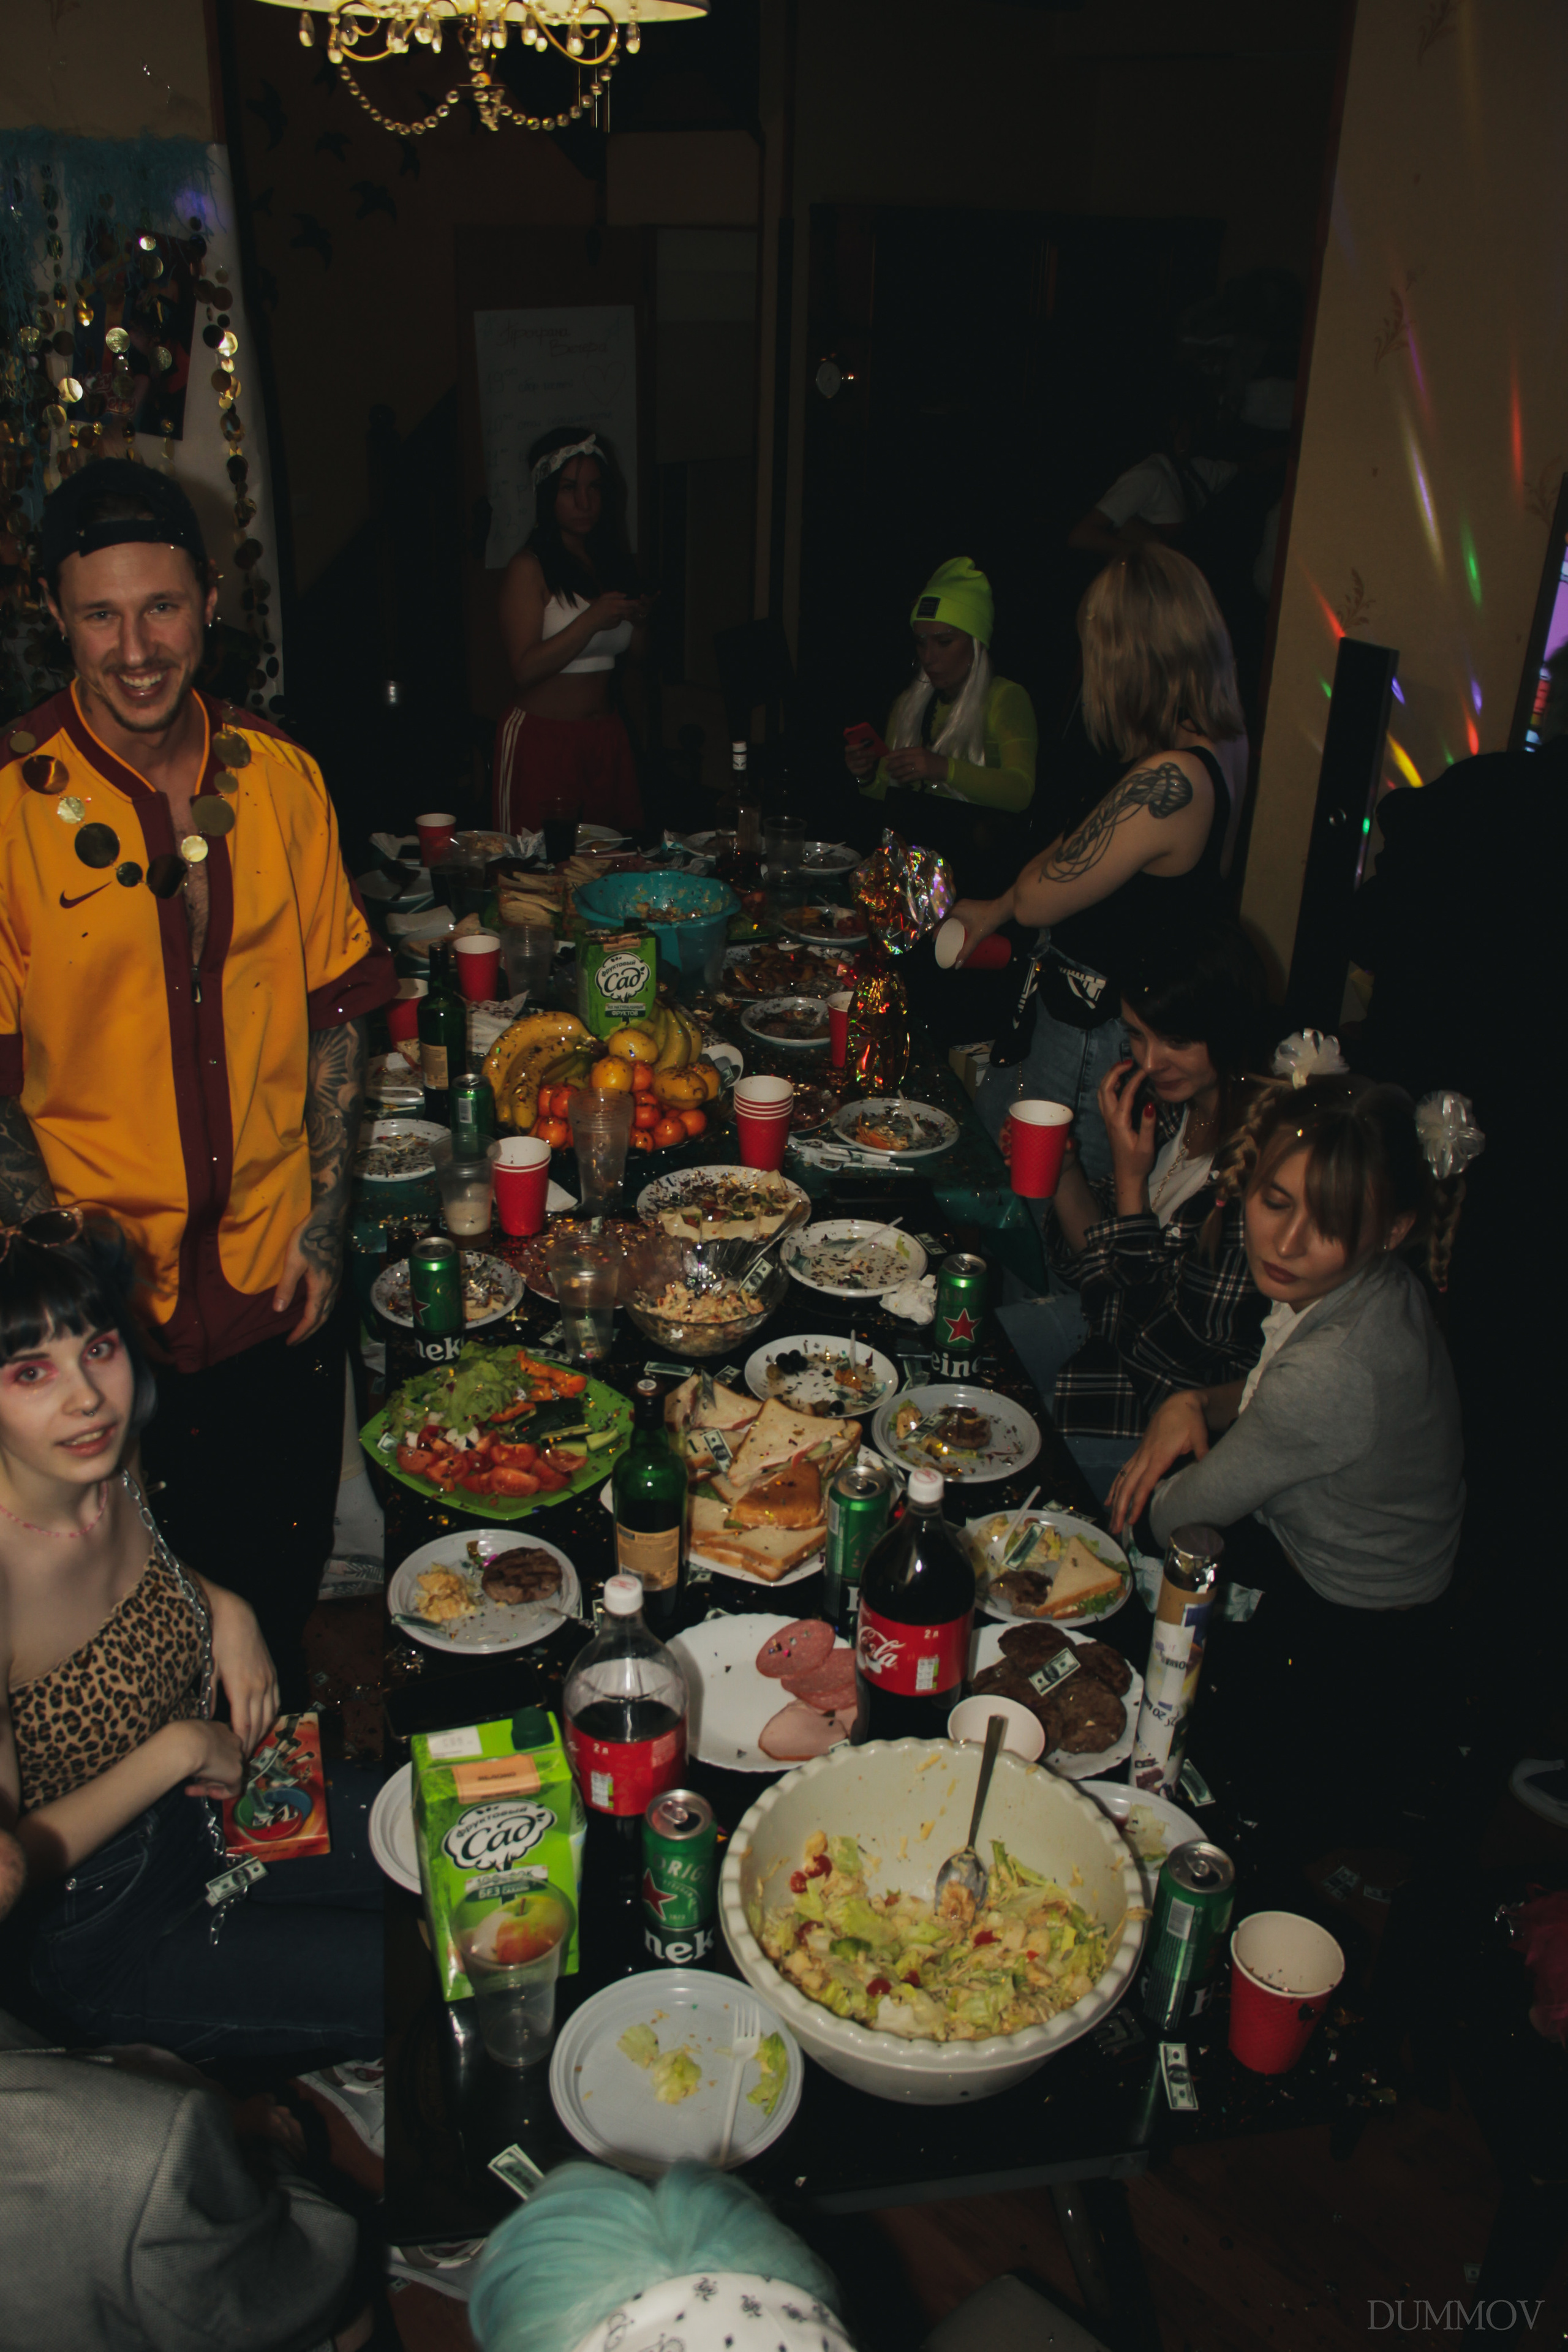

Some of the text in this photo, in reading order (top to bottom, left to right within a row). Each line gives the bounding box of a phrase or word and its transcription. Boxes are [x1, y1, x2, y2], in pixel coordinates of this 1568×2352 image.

[603, 967, 641, 993] Сад
[456, 1806, 528, 1838] фруктовый
[462, 1815, 537, 1860] Сад
[479, 1887, 500, 1900] БЕЗ
[644, 1926, 714, 1964] nek
